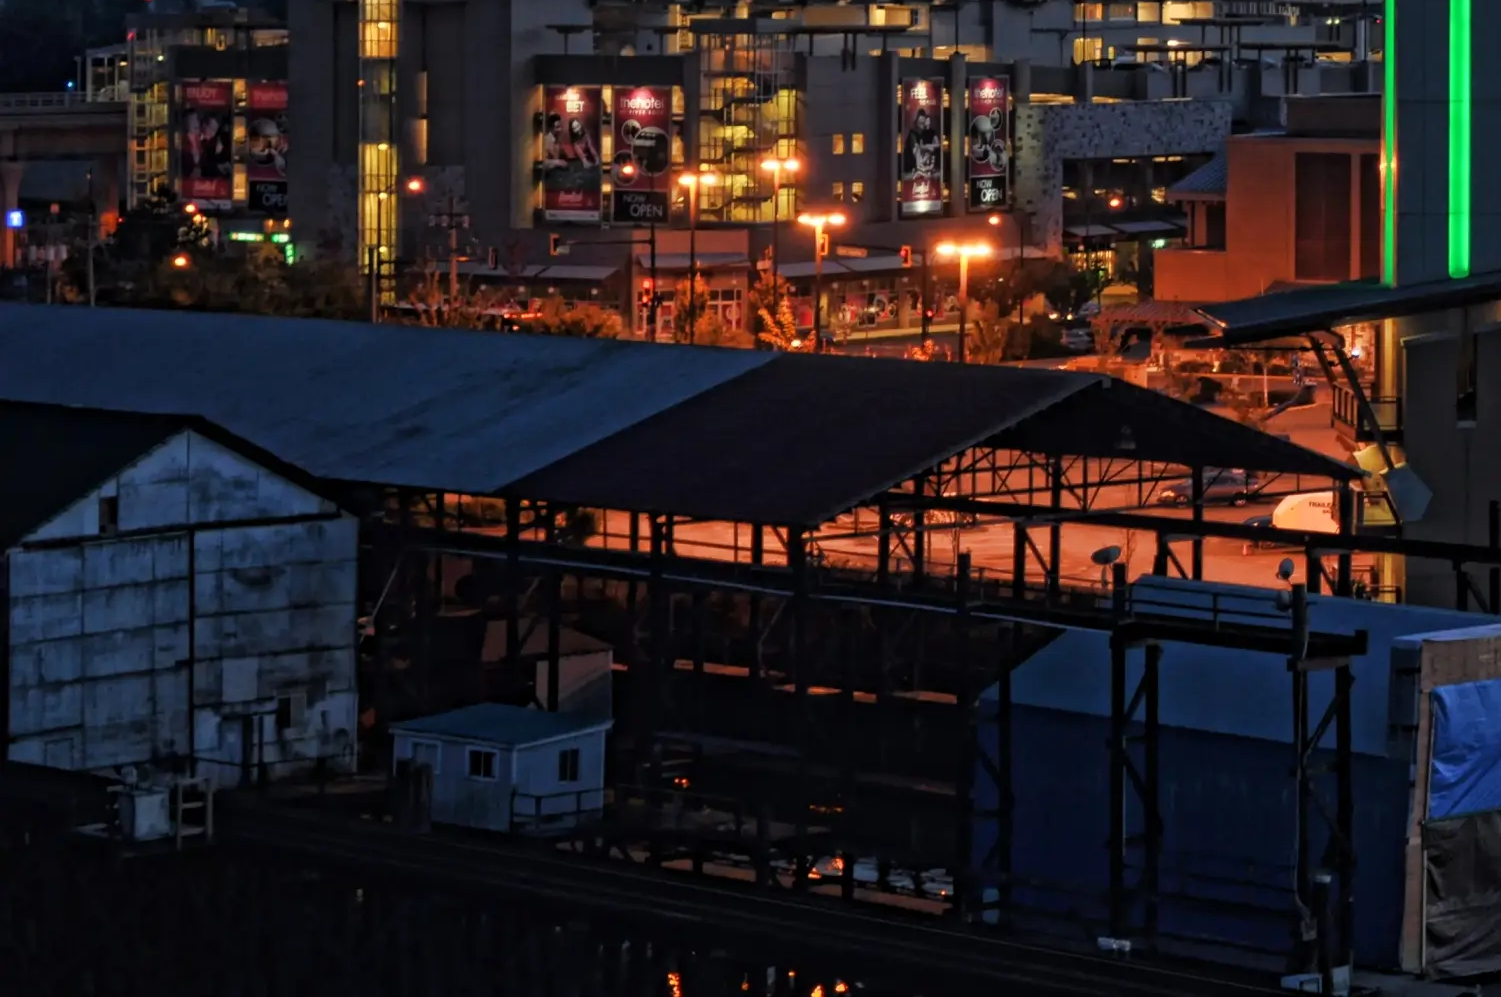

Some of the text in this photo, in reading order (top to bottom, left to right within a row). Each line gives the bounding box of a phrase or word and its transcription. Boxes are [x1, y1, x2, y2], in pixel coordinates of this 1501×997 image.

[623, 194, 646, 203] NOW
[981, 189, 1003, 202] OPEN
[630, 204, 663, 217] OPEN
